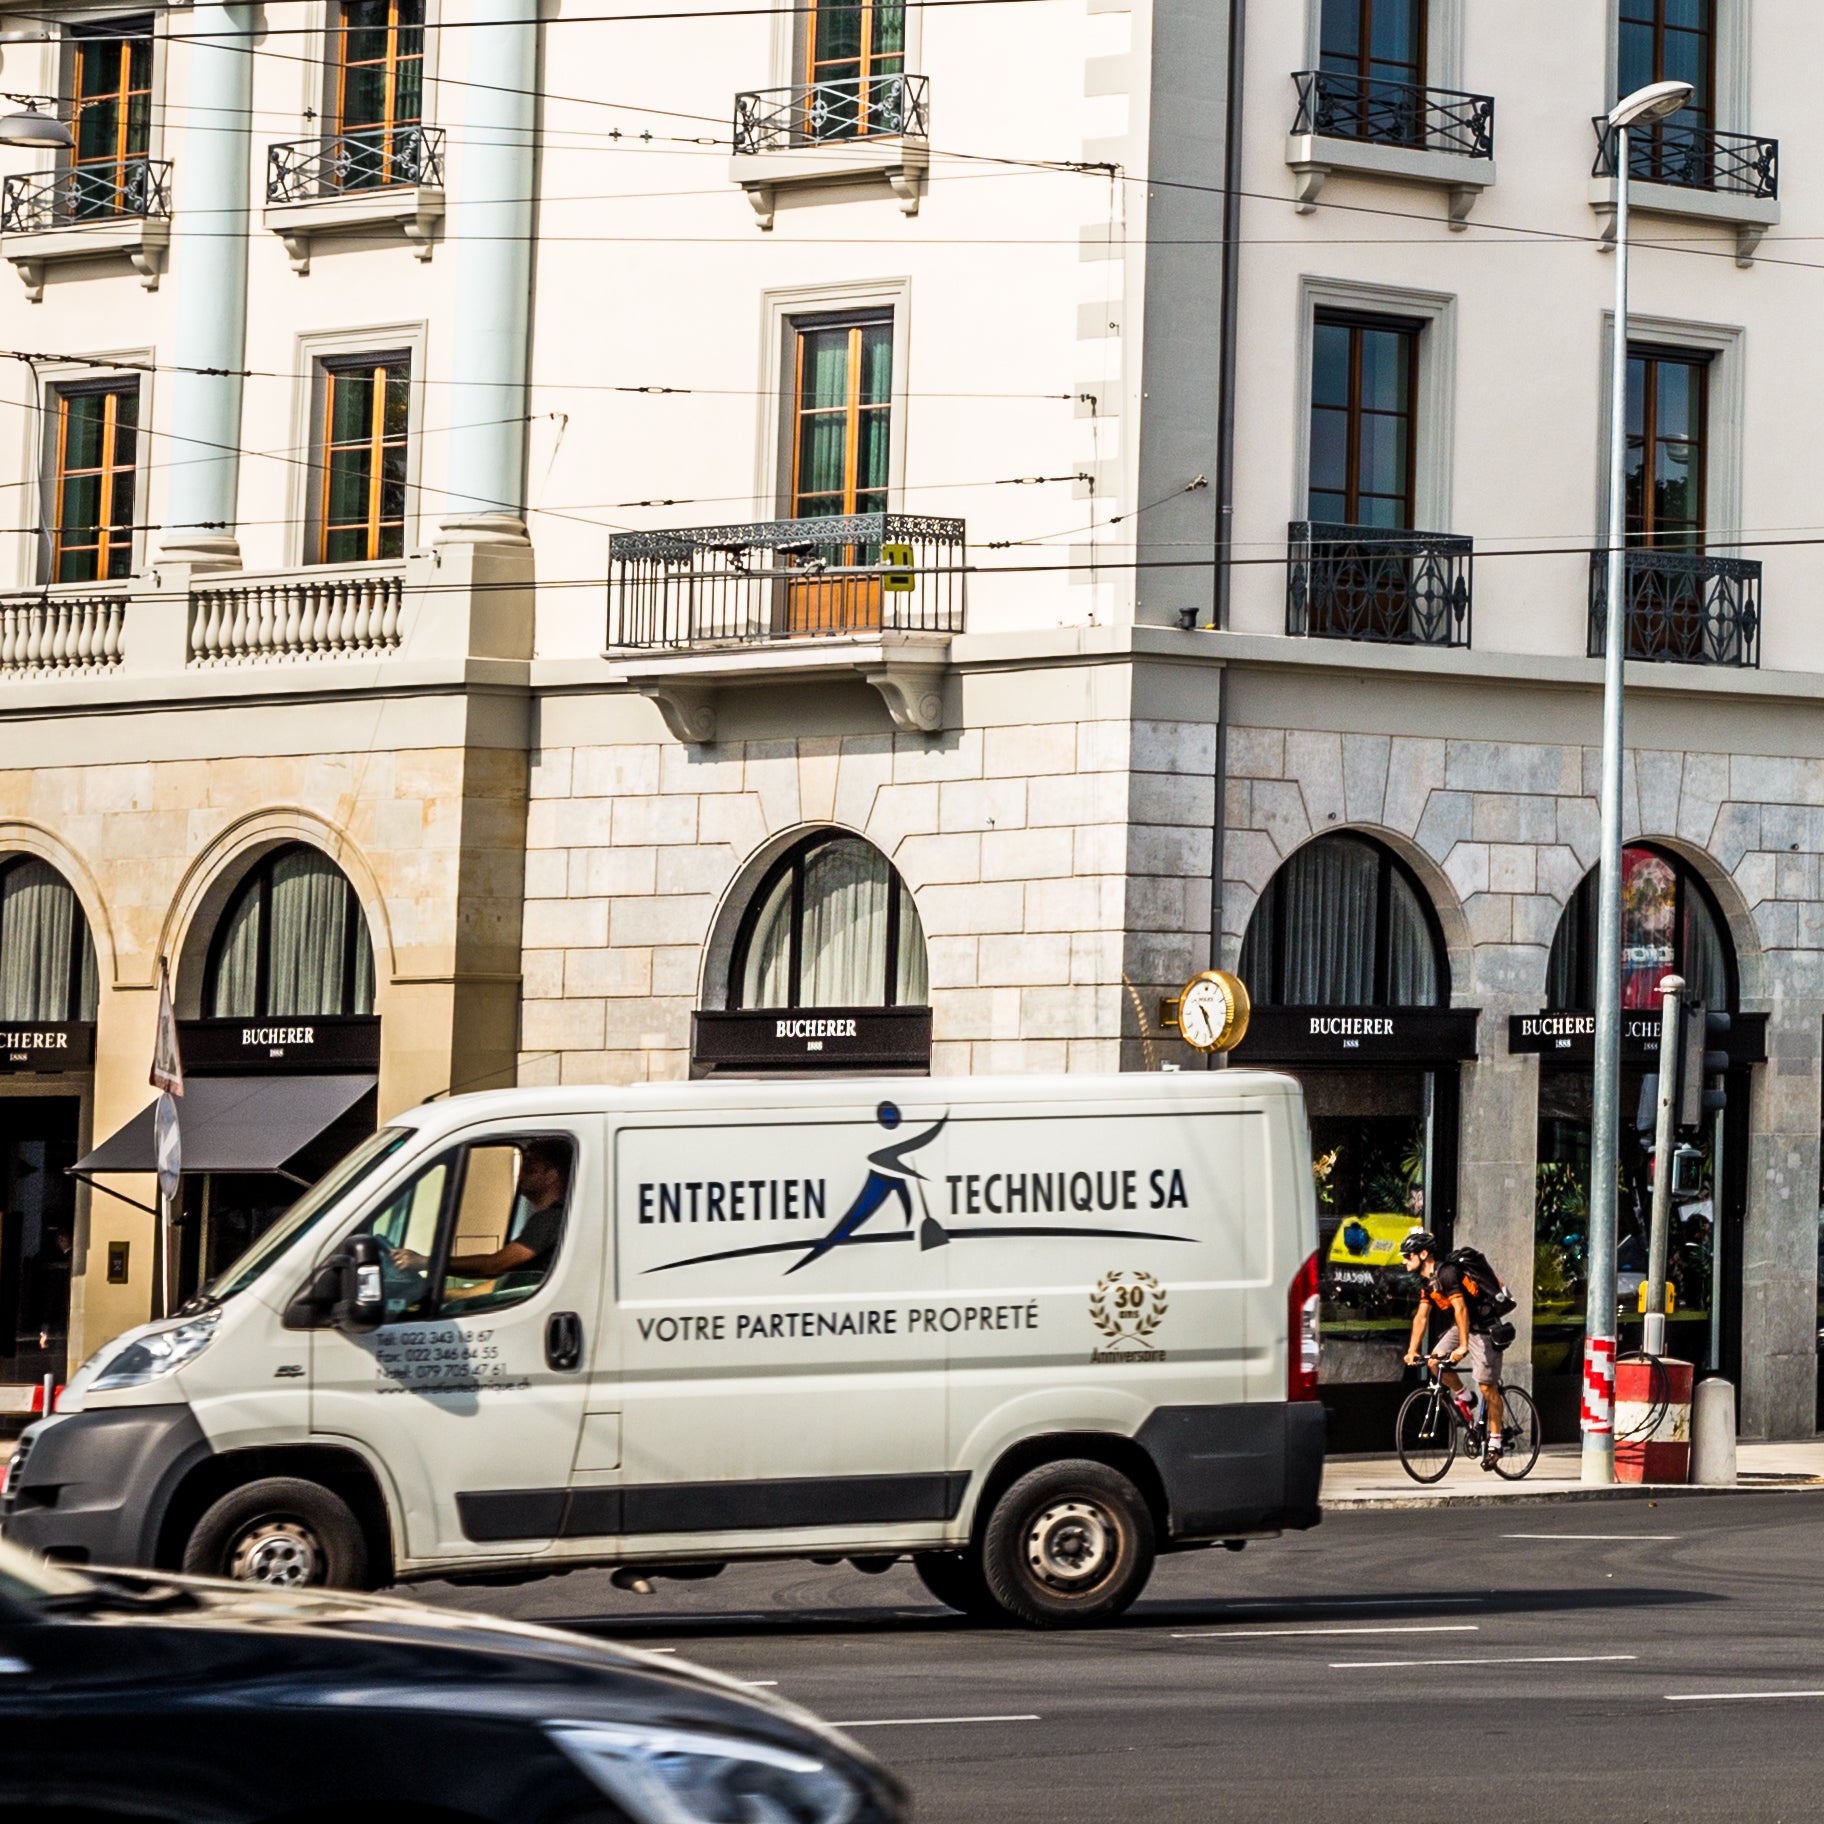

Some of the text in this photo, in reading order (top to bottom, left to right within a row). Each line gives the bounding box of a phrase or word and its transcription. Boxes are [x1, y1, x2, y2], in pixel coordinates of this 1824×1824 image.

[776, 1019, 857, 1037] BUCHERER
[1310, 1017, 1394, 1035] BUCHERER
[1522, 1017, 1595, 1035] BUCHERE
[242, 1027, 314, 1044] BUCHERER
[637, 1168, 1190, 1224] ENTRETIEN TECHNIQUE SA
[1114, 1285, 1144, 1308] 30
[636, 1298, 1039, 1343] VOTRE PARTENAIRE PROPRETÉ
[1090, 1347, 1167, 1364] Anniversaire
